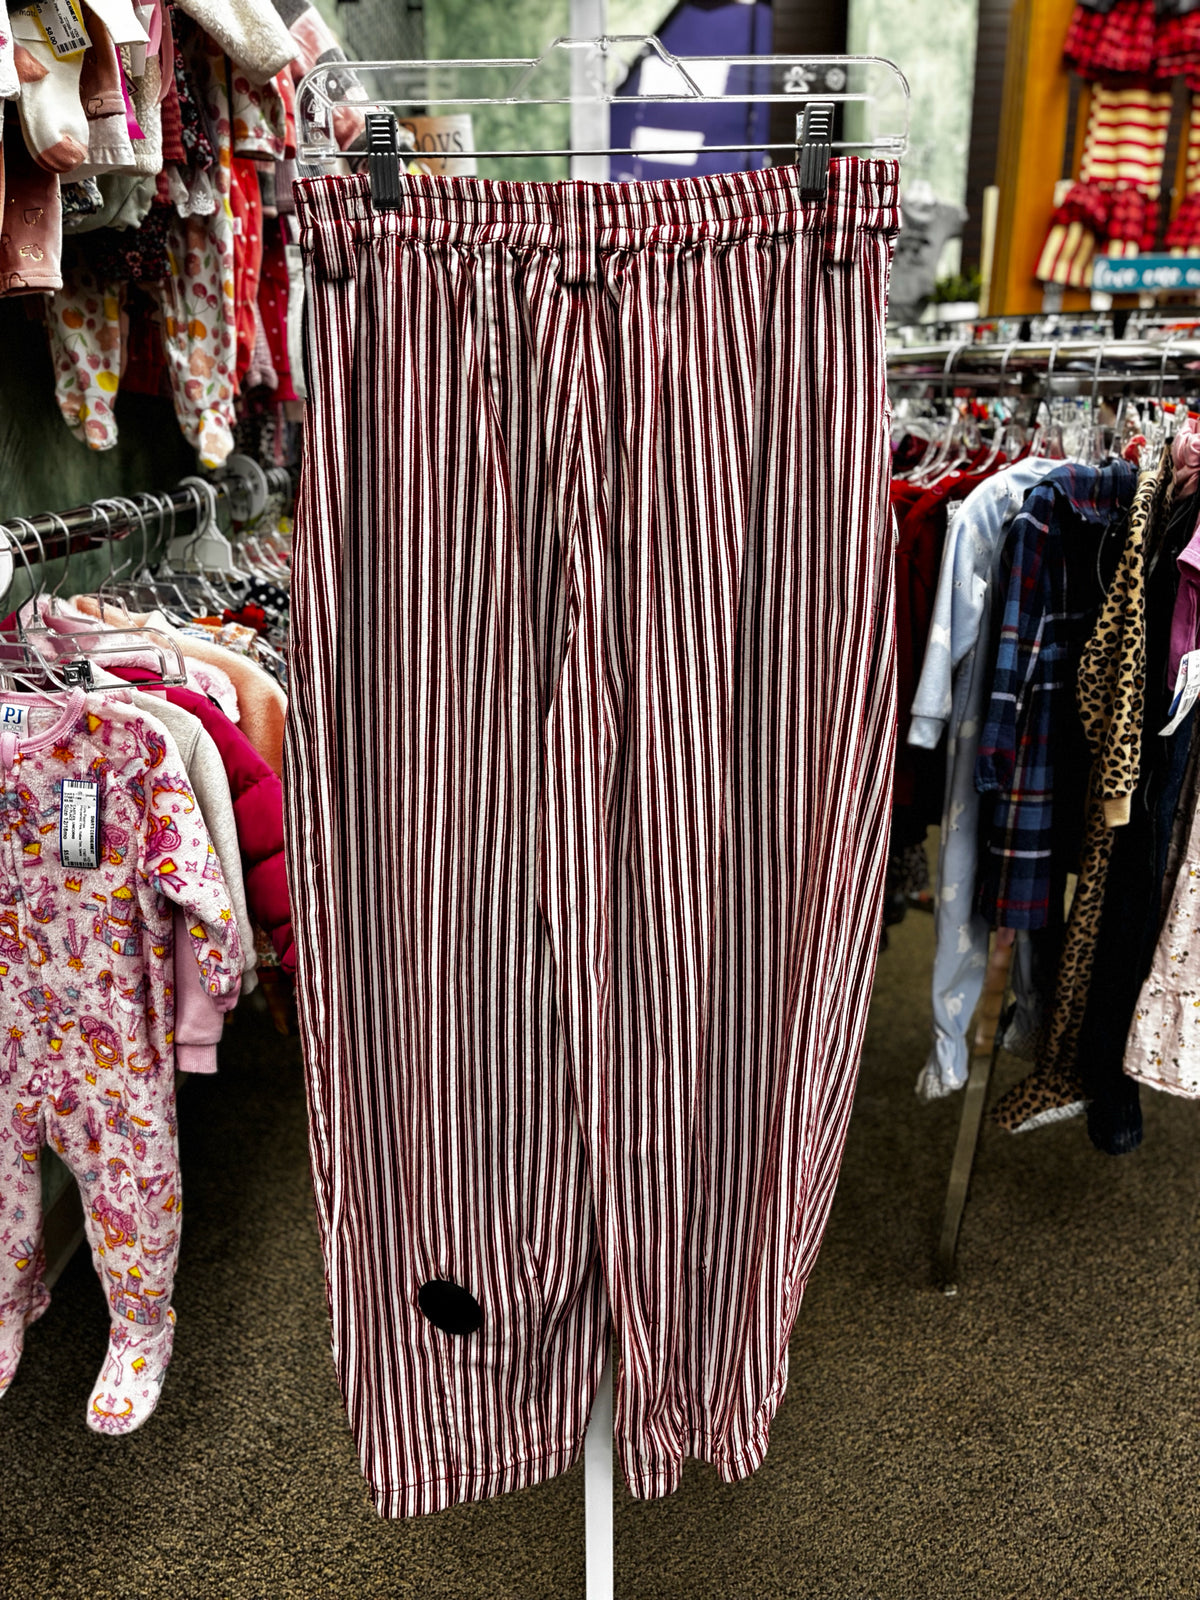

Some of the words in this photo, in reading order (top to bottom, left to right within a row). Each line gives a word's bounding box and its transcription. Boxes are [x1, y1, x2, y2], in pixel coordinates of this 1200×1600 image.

[45, 26, 57, 45] $8.00
[3, 706, 24, 724] PJ
[3, 724, 24, 732] PLACE
